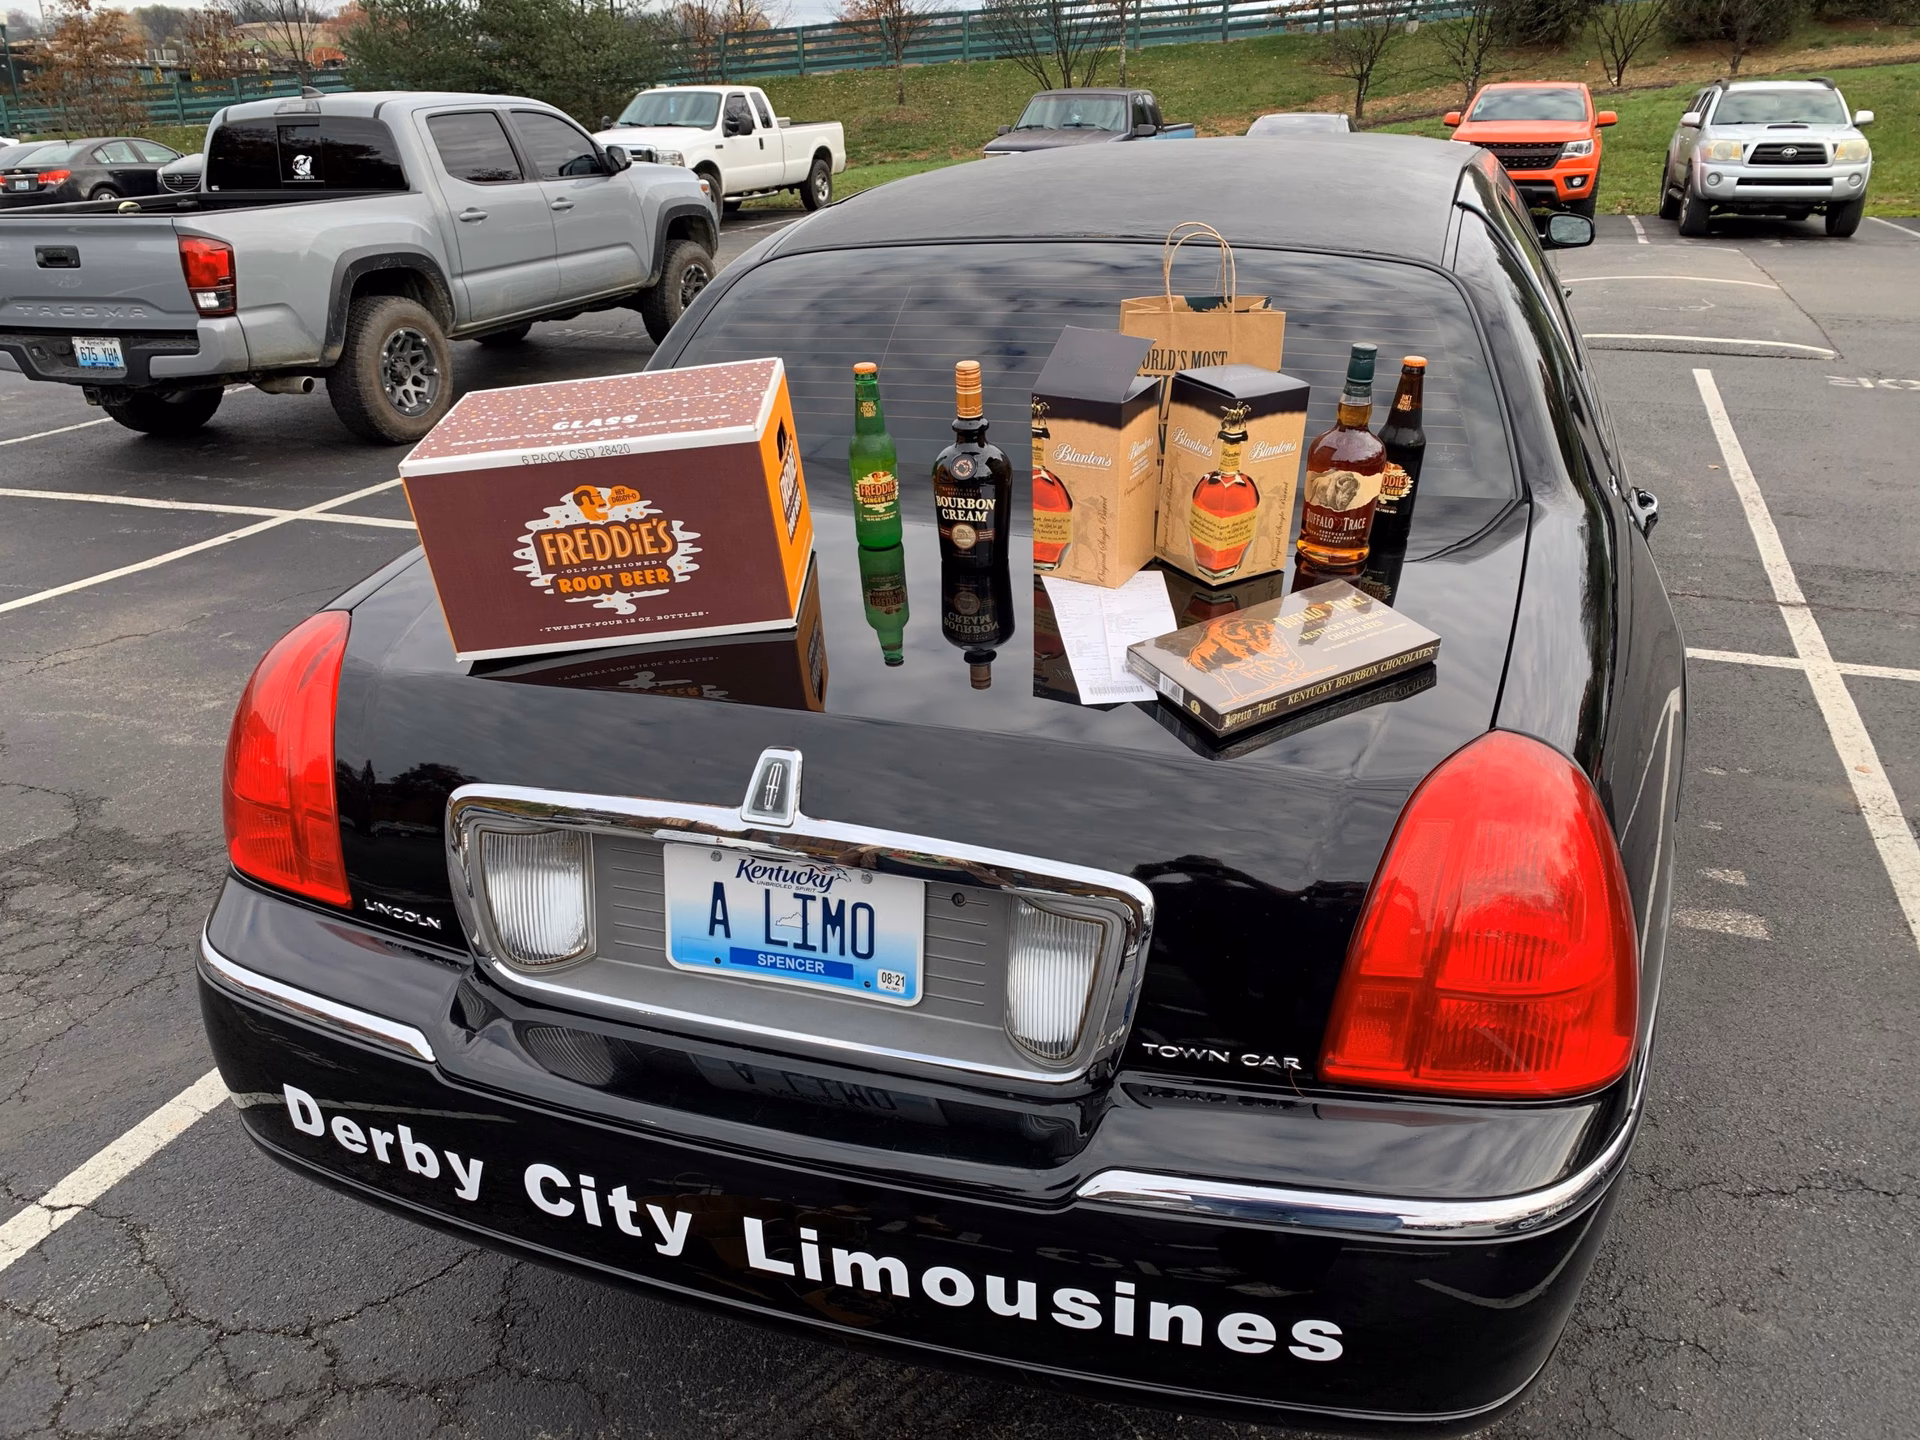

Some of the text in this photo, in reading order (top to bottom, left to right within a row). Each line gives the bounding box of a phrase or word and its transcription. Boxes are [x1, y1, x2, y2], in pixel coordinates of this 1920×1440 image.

[16, 304, 148, 318] TACOMA
[79, 346, 120, 362] 675 YHA
[1142, 349, 1187, 371] ORLD'S
[1190, 350, 1228, 370] MOST
[450, 434, 521, 446] HANDLE
[524, 430, 573, 438] WITH
[669, 416, 704, 424] END
[552, 414, 639, 431] GLASS
[1171, 426, 1213, 458] Blanton's
[1247, 439, 1297, 460] Blanton's
[521, 443, 631, 466] 6 PACK CSD 28420
[1052, 443, 1112, 468] Blanton's
[614, 488, 626, 496] HEY
[936, 495, 997, 511] BOURBON
[942, 508, 989, 523] CREAM
[1306, 508, 1367, 531] BUFFALO TRACE
[557, 567, 671, 595] ROOT BEER
[545, 618, 623, 632] TWENTY-FOUR
[656, 611, 704, 621] BOTTLES
[1273, 607, 1326, 629] BUFFALO
[1325, 594, 1367, 612] TRACE
[1300, 622, 1347, 641] KENTUCKY
[1344, 608, 1389, 626] BOURBON
[1327, 620, 1385, 641] CHOCOLATES
[1225, 645, 1435, 728] BUFFALO TRACE KENTUCKY BOURBON CHOCOLATES
[735, 858, 836, 893] Kentucky
[756, 880, 816, 893] UNBRIDLED SPIRIT
[364, 898, 441, 930] LINCOLN
[708, 881, 875, 960] A LIMO
[757, 953, 825, 974] SPENCER
[1142, 1043, 1302, 1070] TOWN CAR
[283, 1083, 1344, 1361] Derby City Limousines
